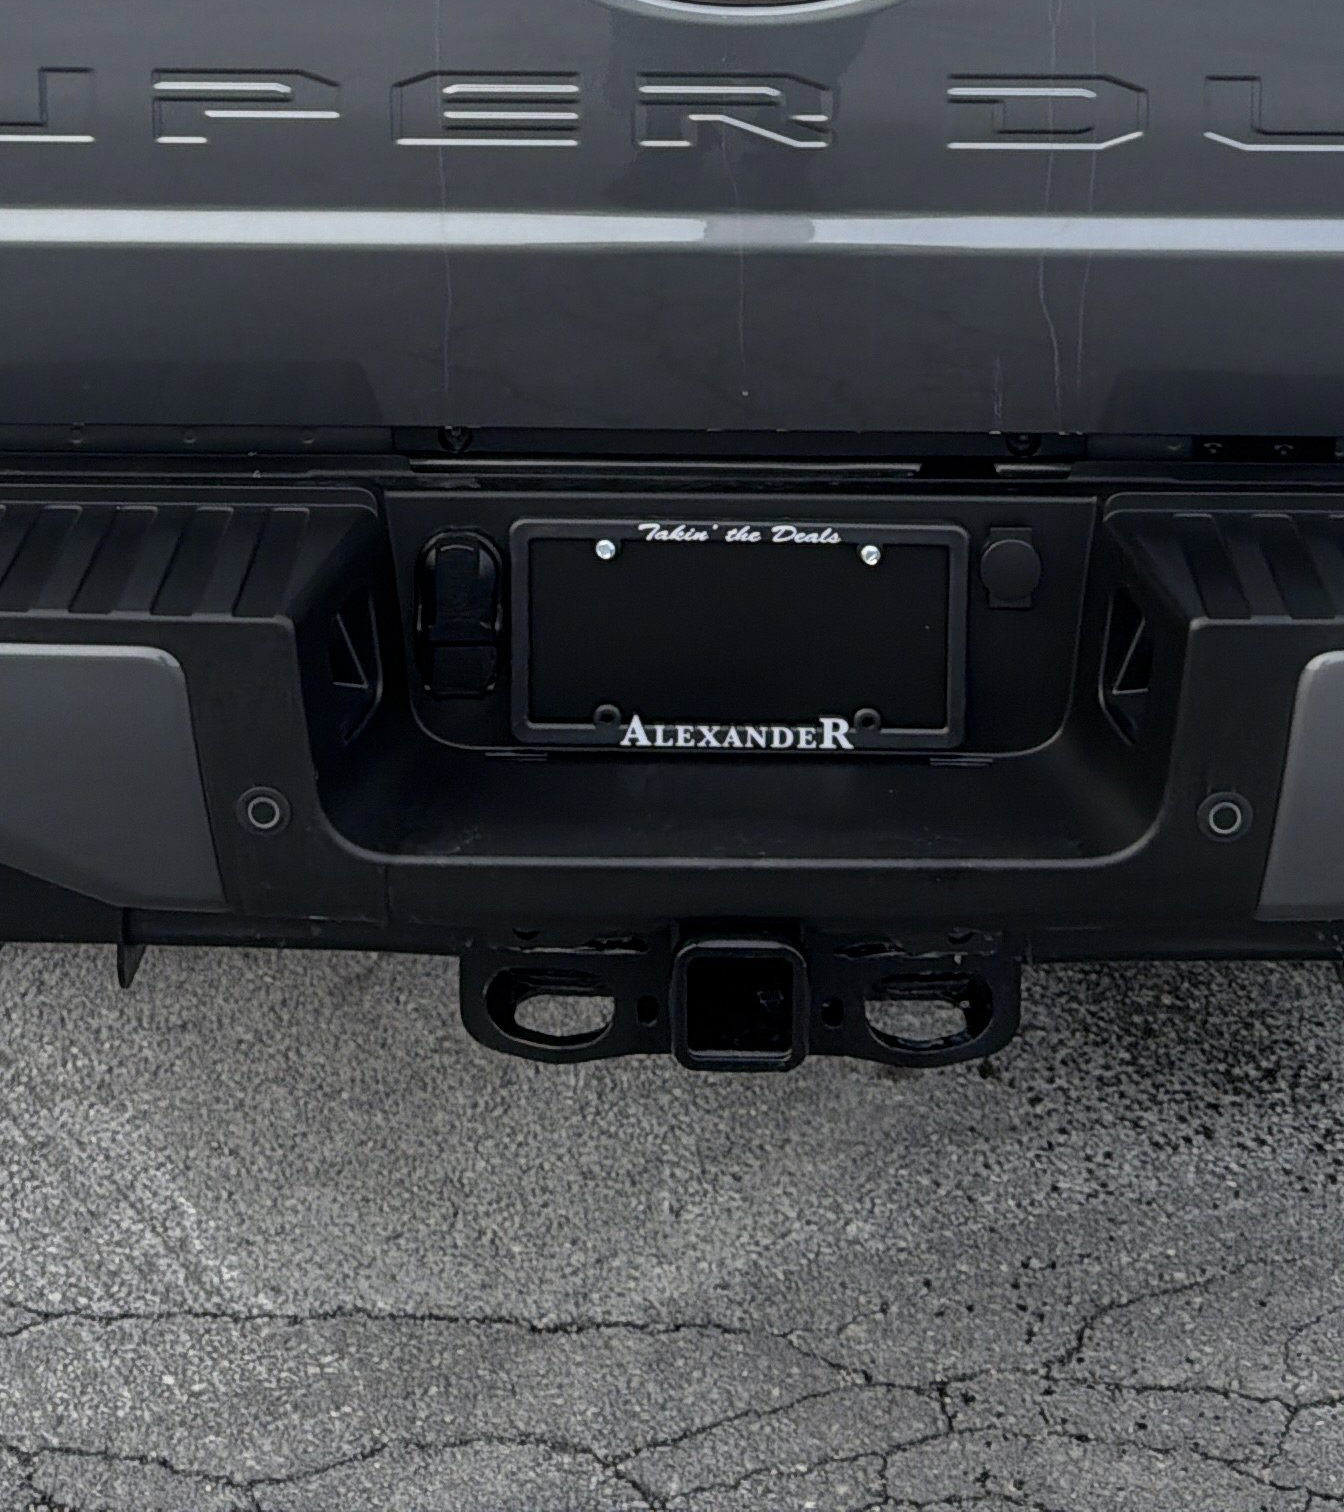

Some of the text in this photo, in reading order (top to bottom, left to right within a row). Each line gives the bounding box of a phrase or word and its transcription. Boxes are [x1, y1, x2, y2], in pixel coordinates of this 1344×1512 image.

[725, 525, 762, 543] the
[771, 524, 842, 544] Deals
[619, 714, 855, 750] ALEXANDER
